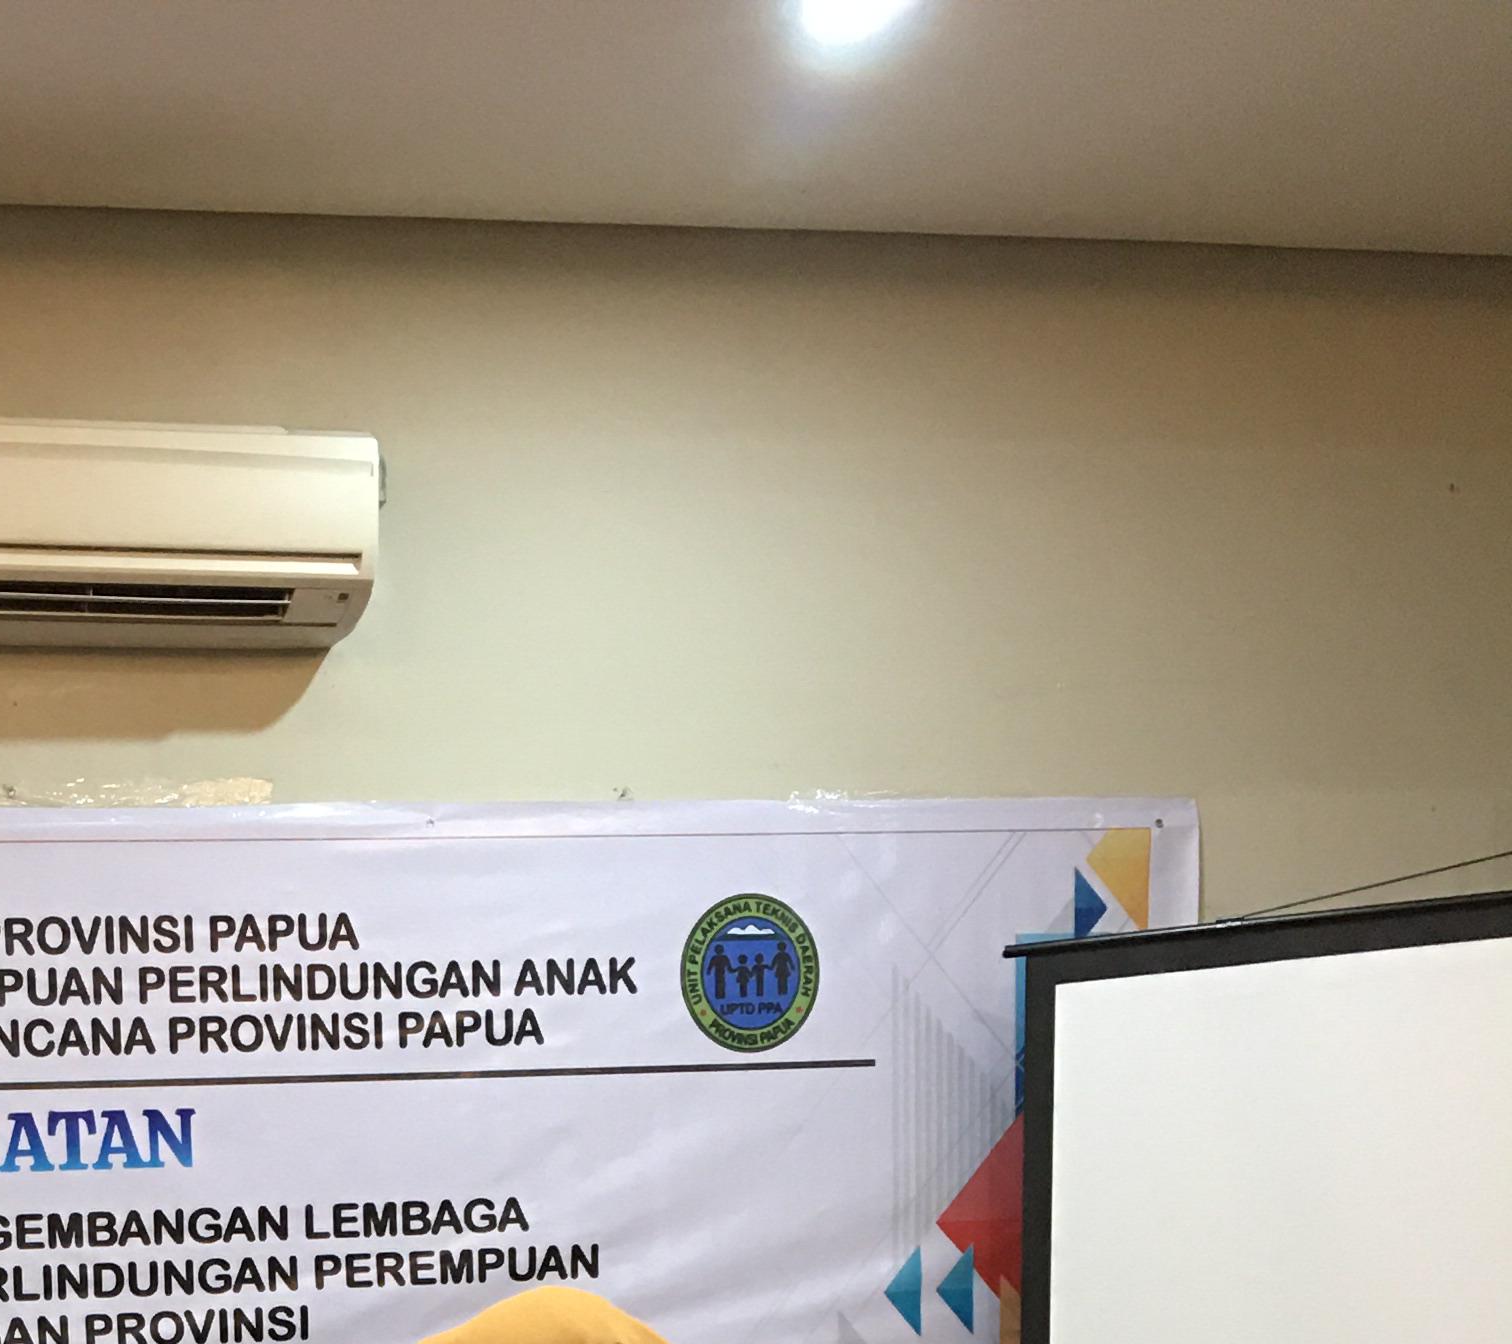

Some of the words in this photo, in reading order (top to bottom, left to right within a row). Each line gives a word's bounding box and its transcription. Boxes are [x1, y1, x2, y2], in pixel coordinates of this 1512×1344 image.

[209, 912, 360, 953] PAPUA
[689, 901, 753, 966] PELAKSANA
[138, 959, 501, 1005] PERLINDUNGAN
[514, 956, 638, 997] ANAK
[687, 969, 703, 1005] UNIT
[794, 933, 813, 998] DAERAH
[168, 1011, 383, 1055] PROVINSI
[398, 1008, 545, 1049] PAPUA
[304, 1196, 530, 1240] LEMBAGA
[314, 1243, 600, 1290] PEREMPUAN
